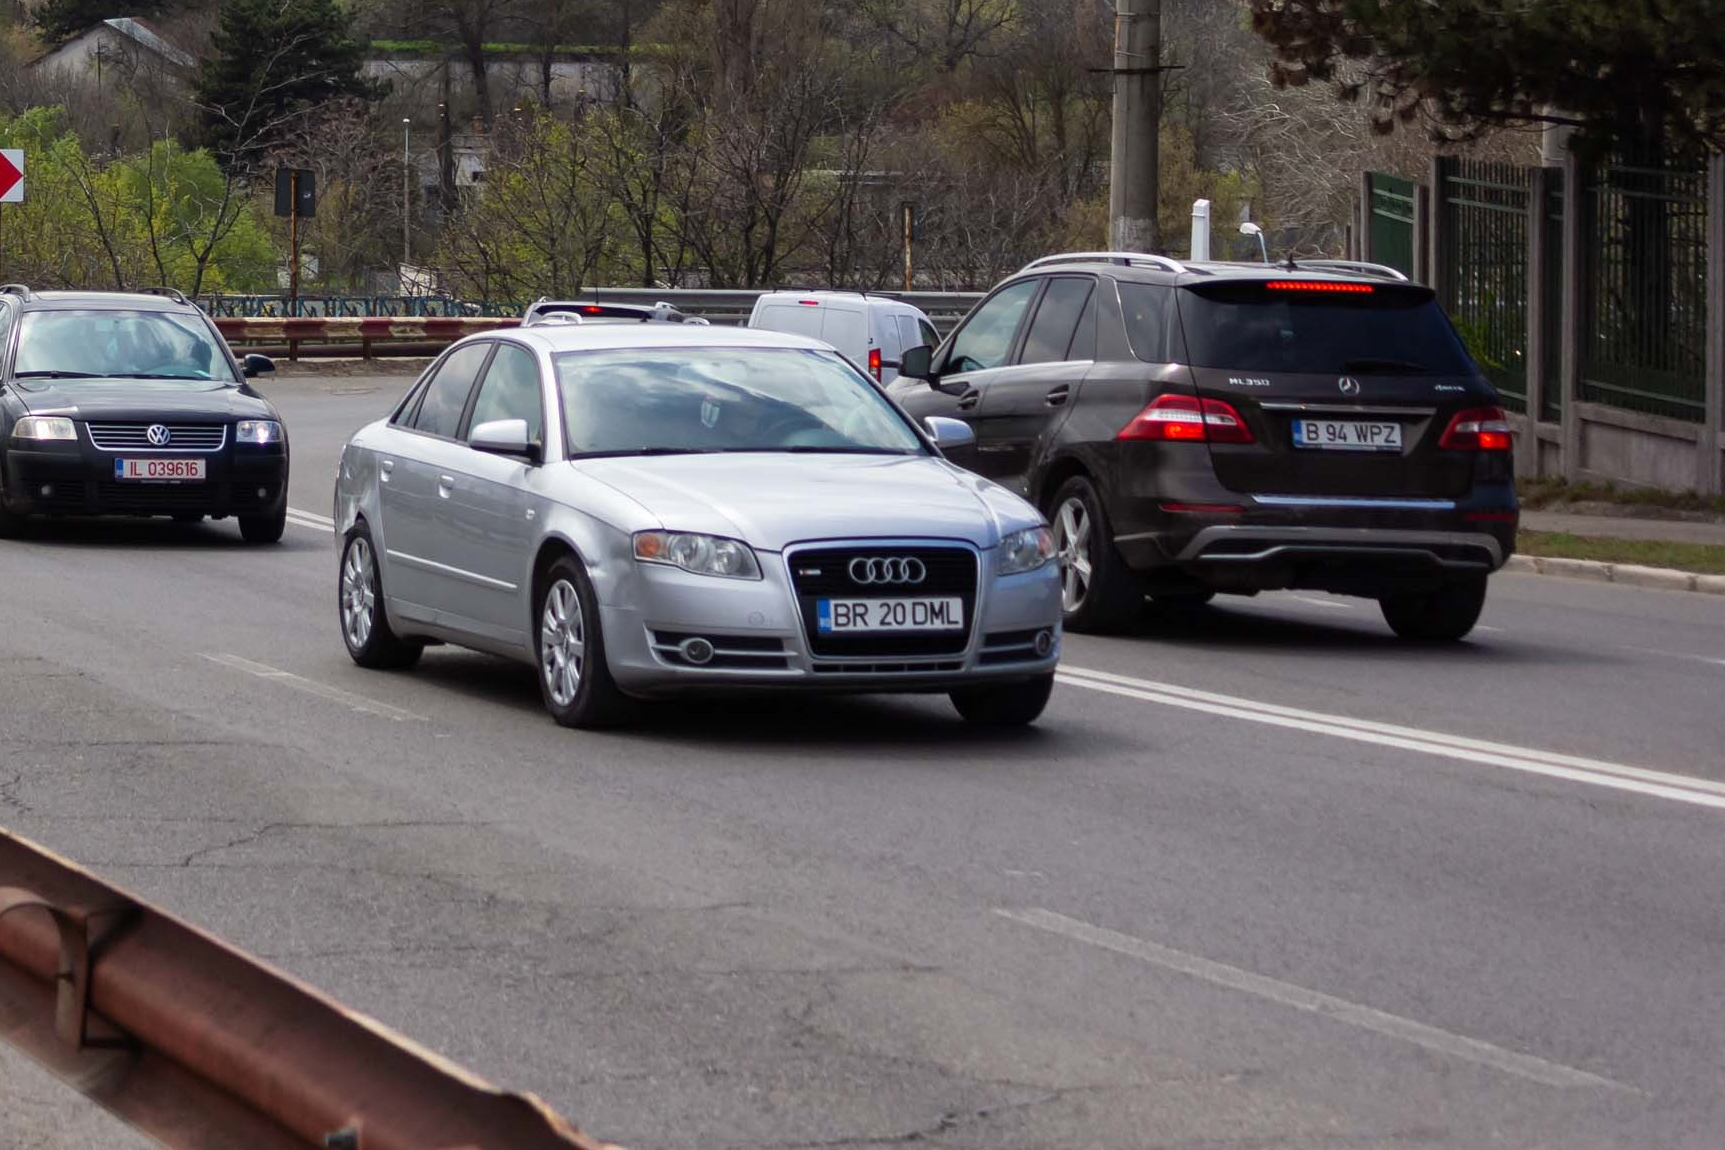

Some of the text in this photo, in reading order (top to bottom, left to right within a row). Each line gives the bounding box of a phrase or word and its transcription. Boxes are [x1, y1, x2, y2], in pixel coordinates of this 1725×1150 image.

[1306, 422, 1397, 444] B 94 WPZ
[130, 461, 143, 476] IL
[148, 461, 199, 477] 039616
[833, 601, 960, 627] BR 20 DML
